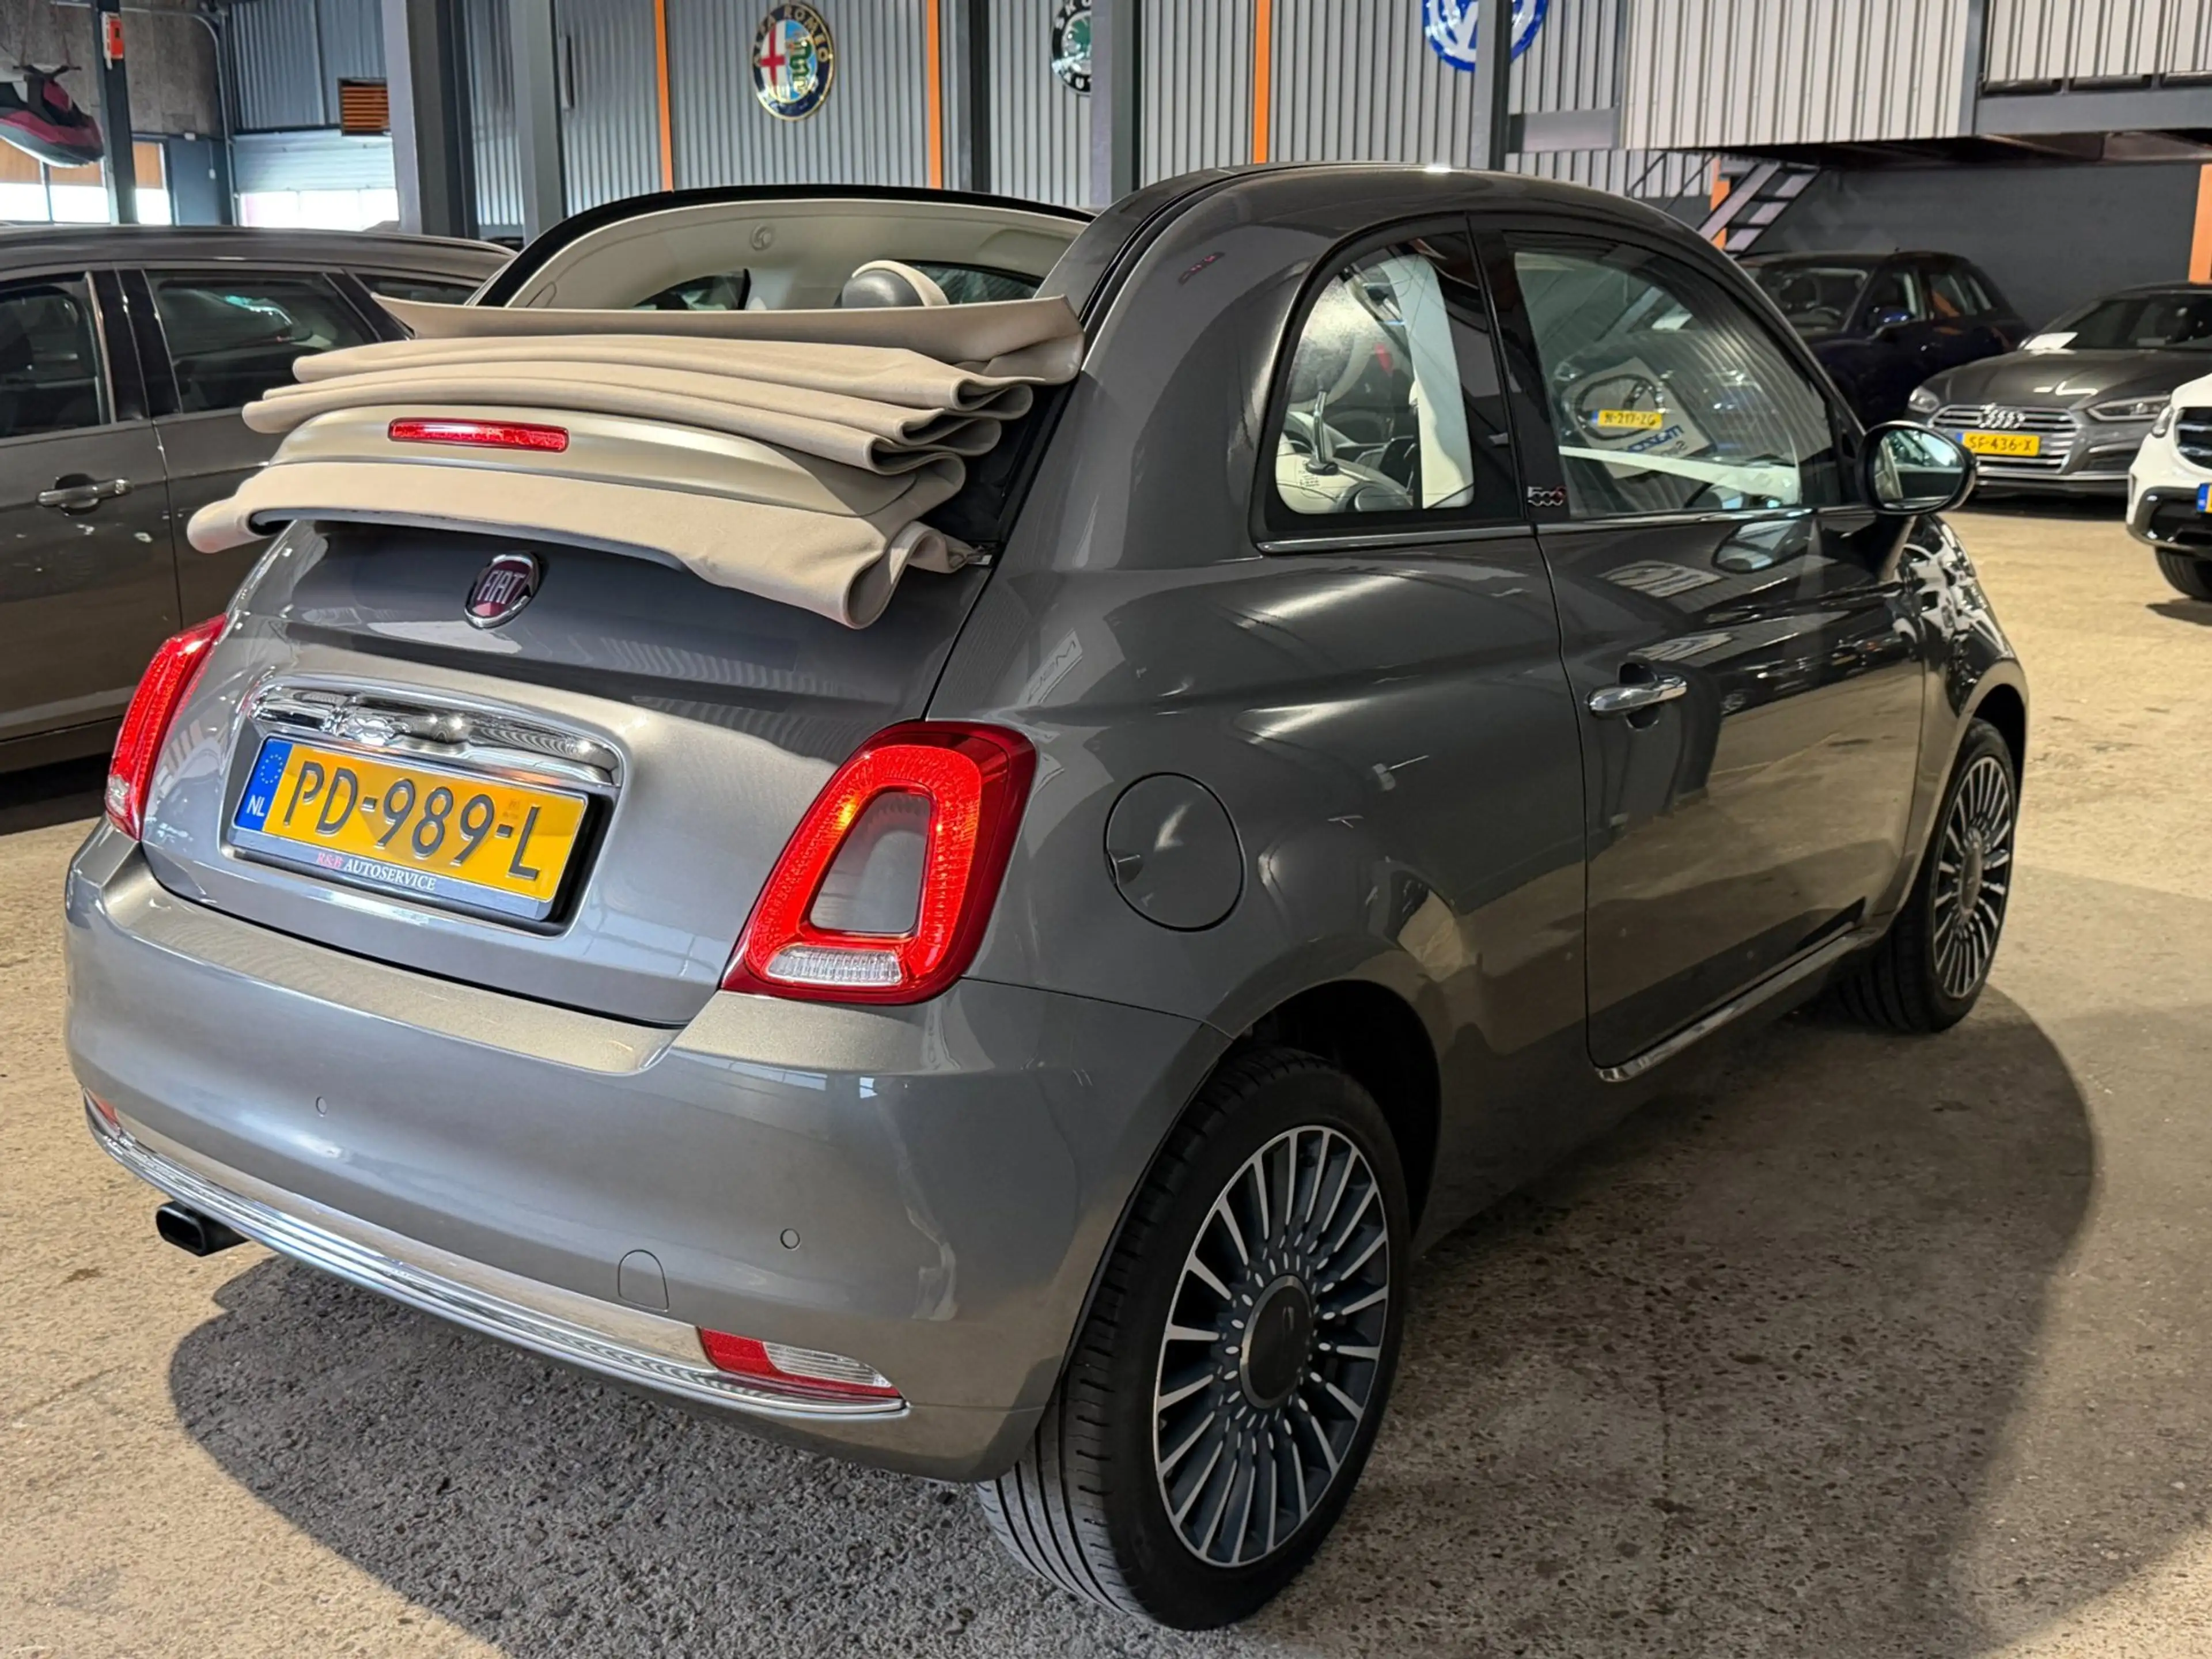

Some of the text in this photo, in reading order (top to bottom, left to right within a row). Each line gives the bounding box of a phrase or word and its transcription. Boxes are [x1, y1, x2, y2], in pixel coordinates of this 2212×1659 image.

[783, 5, 829, 62] ROMEO
[1063, 71, 1092, 89] AU
[1969, 435, 2032, 452] SF-436-X
[1527, 486, 1566, 507] 500
[476, 570, 527, 605] FIAT
[245, 794, 266, 817] NL
[283, 760, 541, 881] PD-989-L
[343, 858, 437, 891] AUTOSERVICE
